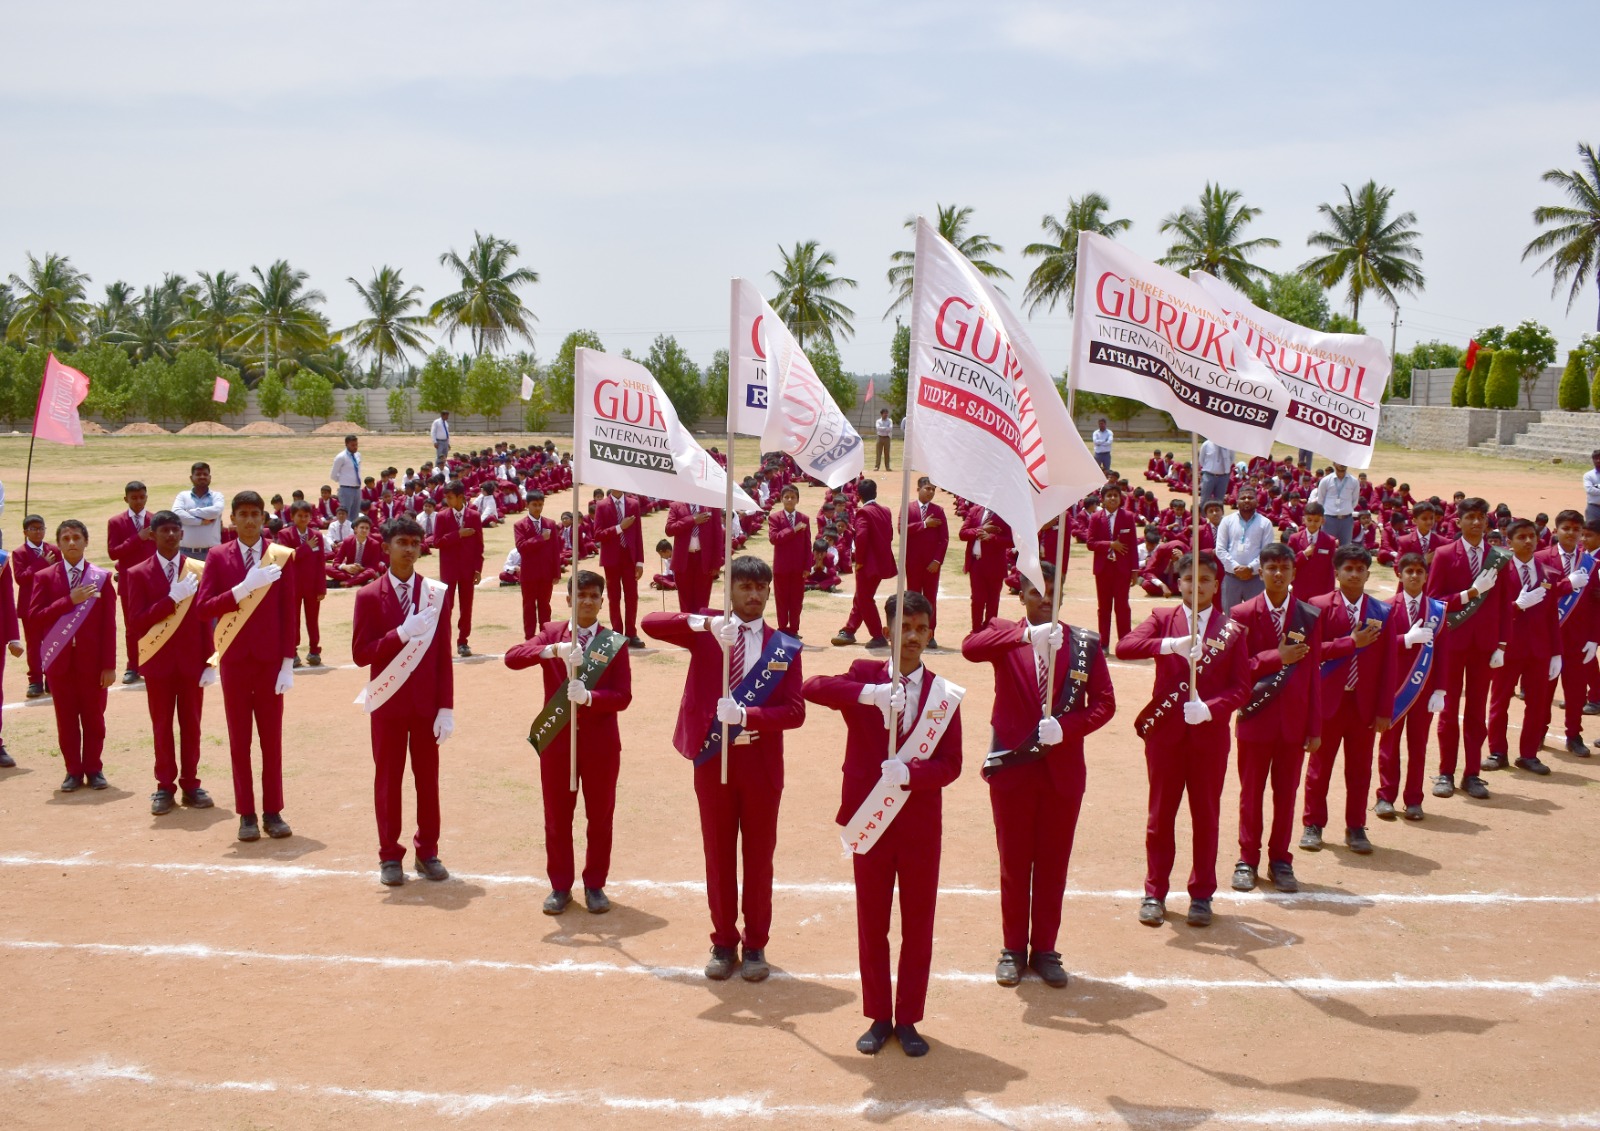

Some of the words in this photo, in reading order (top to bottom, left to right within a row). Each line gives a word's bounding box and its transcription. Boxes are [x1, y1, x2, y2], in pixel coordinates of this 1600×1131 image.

[1129, 277, 1165, 299] SHREE
[1096, 271, 1236, 375] GURUK
[1235, 311, 1265, 334] SHREE
[1267, 331, 1356, 368] SWAMINARAYAN
[1099, 324, 1202, 381] INTERNATIONAL
[1206, 371, 1274, 404] SCHOOL
[923, 383, 957, 410] VIDYA
[1096, 346, 1201, 405] ATHARVAVEDA
[1206, 396, 1269, 423] HOUSE
[1295, 403, 1368, 443] HOUSE
[1310, 389, 1368, 423] SCHOOL
[593, 443, 677, 472] YAJURVE
